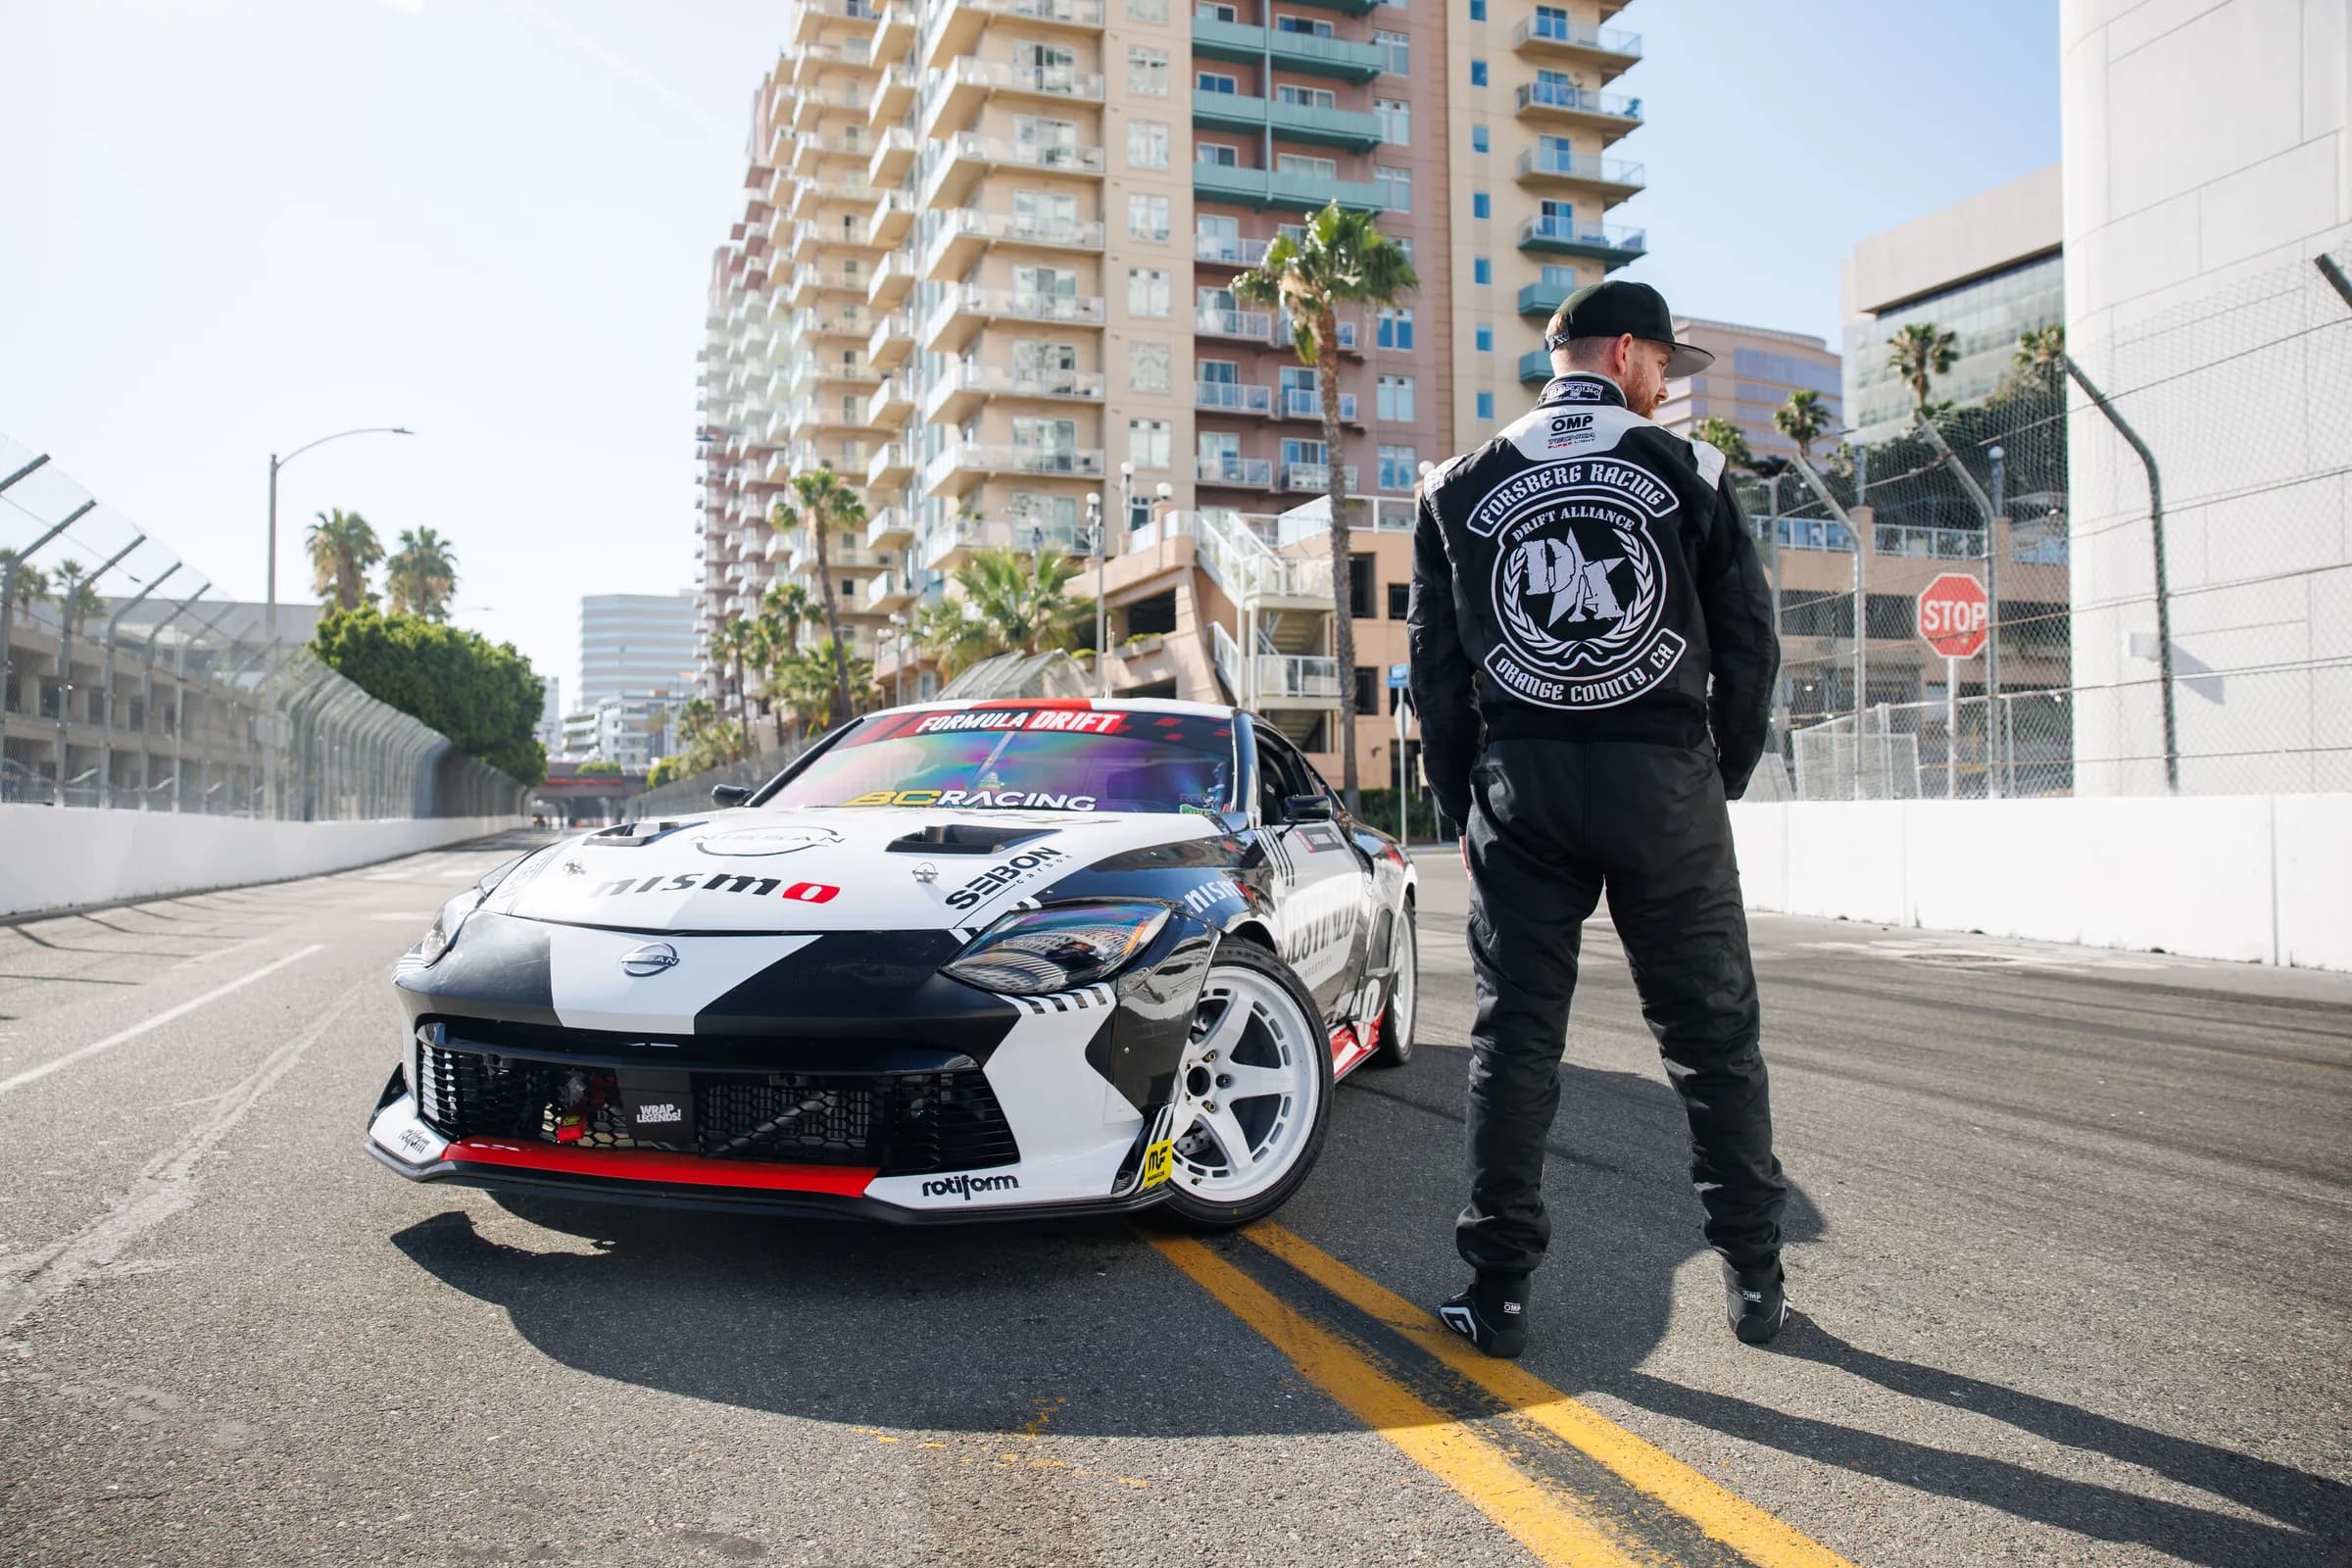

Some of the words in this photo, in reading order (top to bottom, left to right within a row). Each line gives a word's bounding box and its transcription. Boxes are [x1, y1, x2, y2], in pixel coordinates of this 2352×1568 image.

[1551, 416, 1593, 431] OMP
[1479, 465, 1582, 525] FORSBERG
[1590, 464, 1666, 506] RACING
[1511, 510, 1556, 542] DRIFT
[1560, 506, 1636, 531] ALLIANCE
[1924, 600, 1988, 632] STOP
[1495, 658, 1564, 701] ORANGE
[1649, 642, 1675, 669] CA
[915, 711, 1029, 733] FORMULA
[1029, 710, 1120, 732] DRIFT
[945, 847, 1063, 909] SEIBON
[636, 1109, 682, 1123] LEGENDS!
[640, 1104, 674, 1115] WRAP
[922, 1174, 1019, 1200] rotiform
